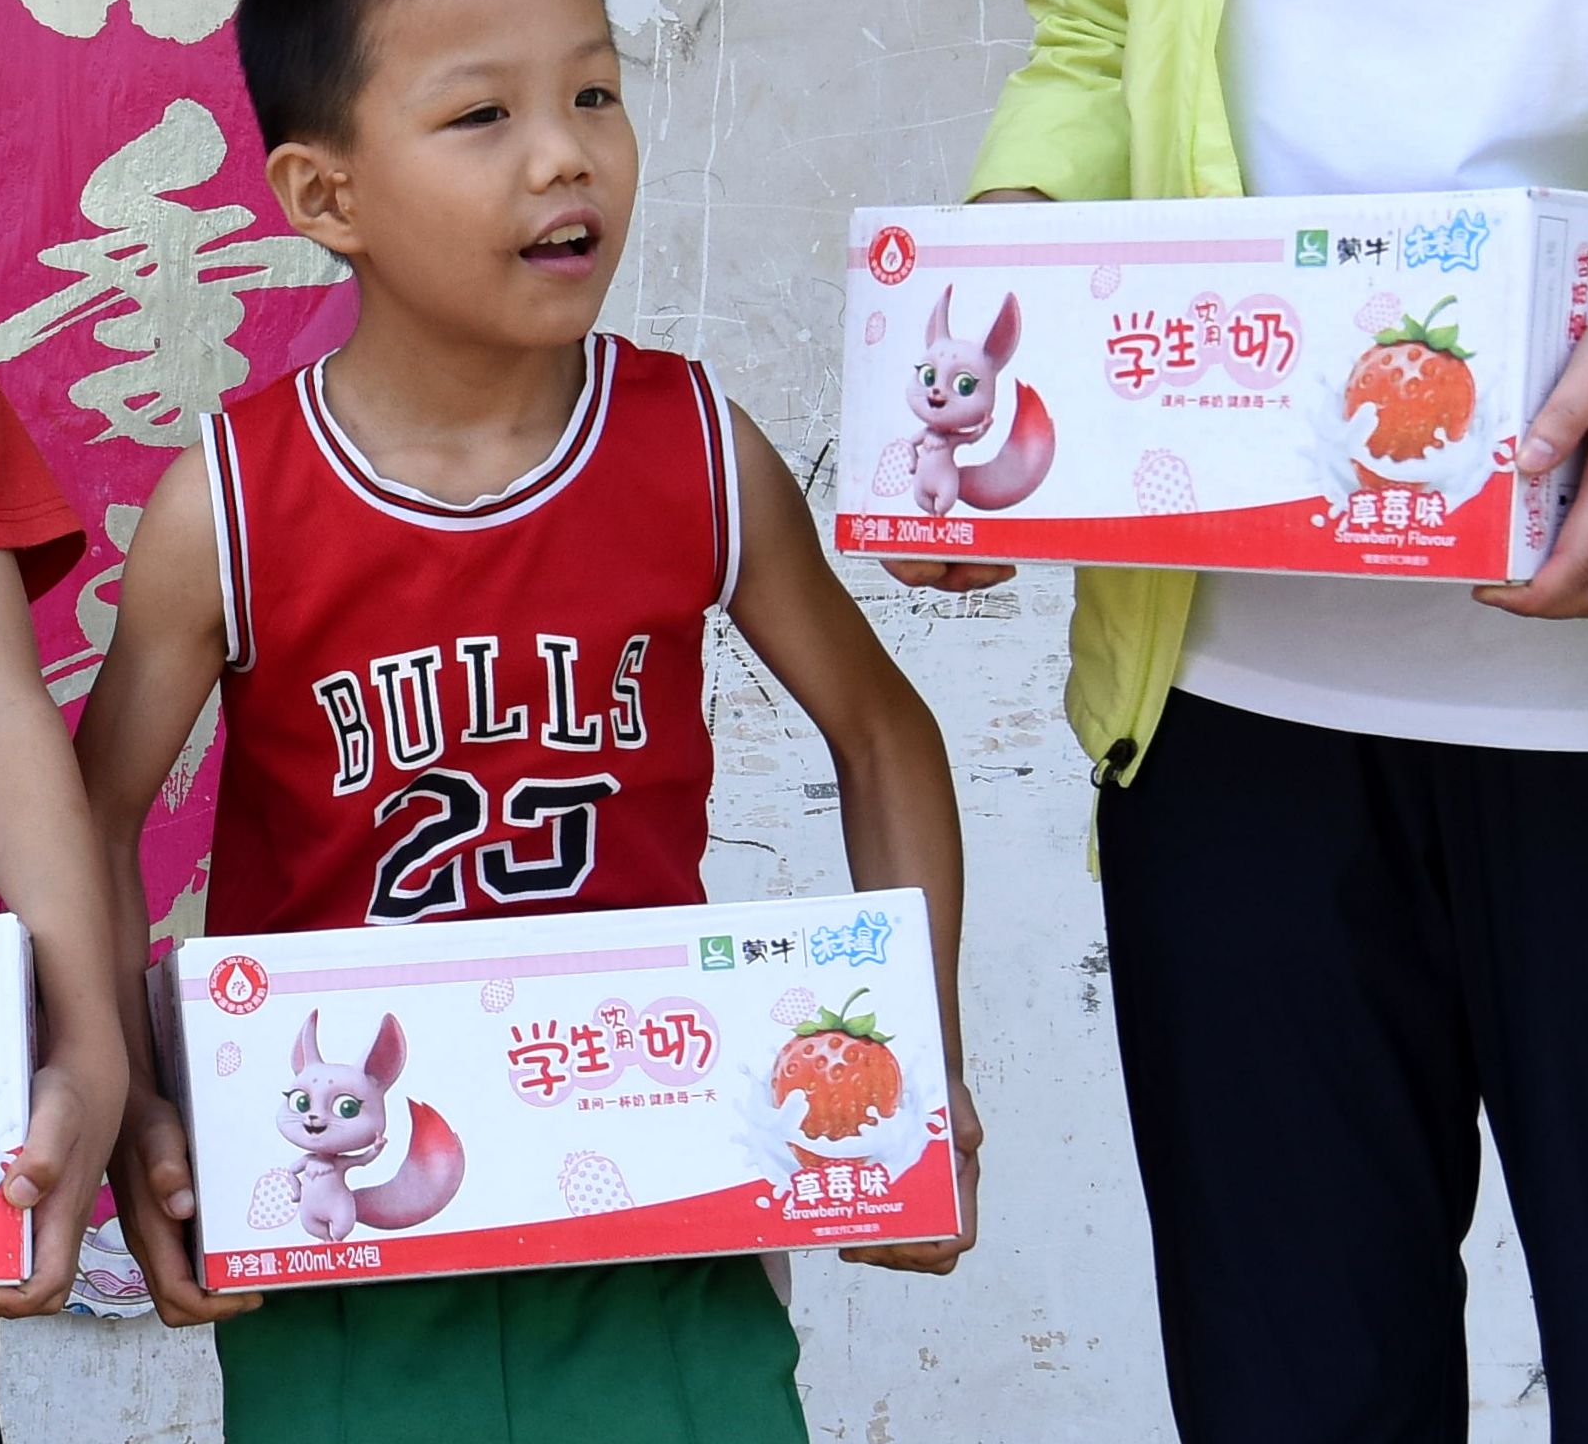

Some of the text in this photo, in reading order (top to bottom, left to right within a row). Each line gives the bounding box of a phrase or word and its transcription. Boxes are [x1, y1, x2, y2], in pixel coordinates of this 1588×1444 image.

[1350, 489, 1444, 529] 草莓味
[1408, 531, 1457, 547] Flavour
[312, 633, 650, 797] BULLS
[741, 936, 795, 966] 蒙牛
[811, 911, 892, 967] 未来星
[794, 1165, 890, 1206] 草莓味
[782, 1201, 904, 1221] Strawberry Flavour
